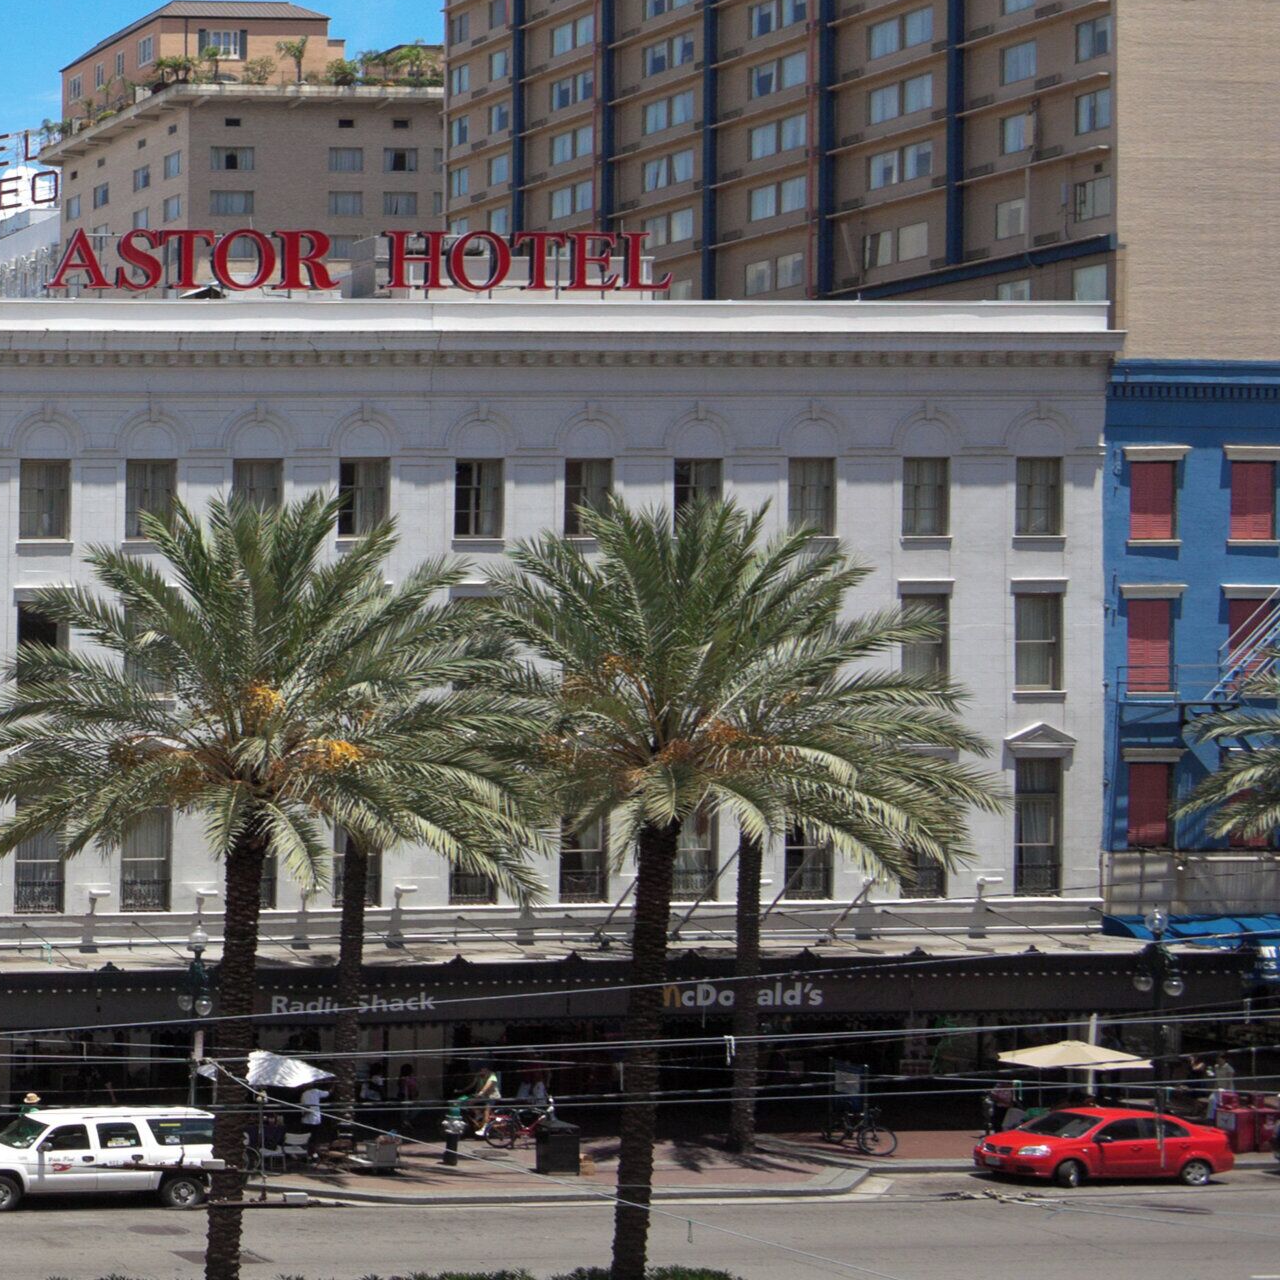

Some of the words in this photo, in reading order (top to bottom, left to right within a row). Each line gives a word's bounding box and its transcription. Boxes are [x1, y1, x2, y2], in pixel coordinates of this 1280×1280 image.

[46, 227, 340, 291] ASTOR
[380, 229, 673, 293] HOTEL
[271, 995, 339, 1015] Radi
[357, 992, 436, 1014] Shack
[662, 982, 823, 1008] McDoald's
